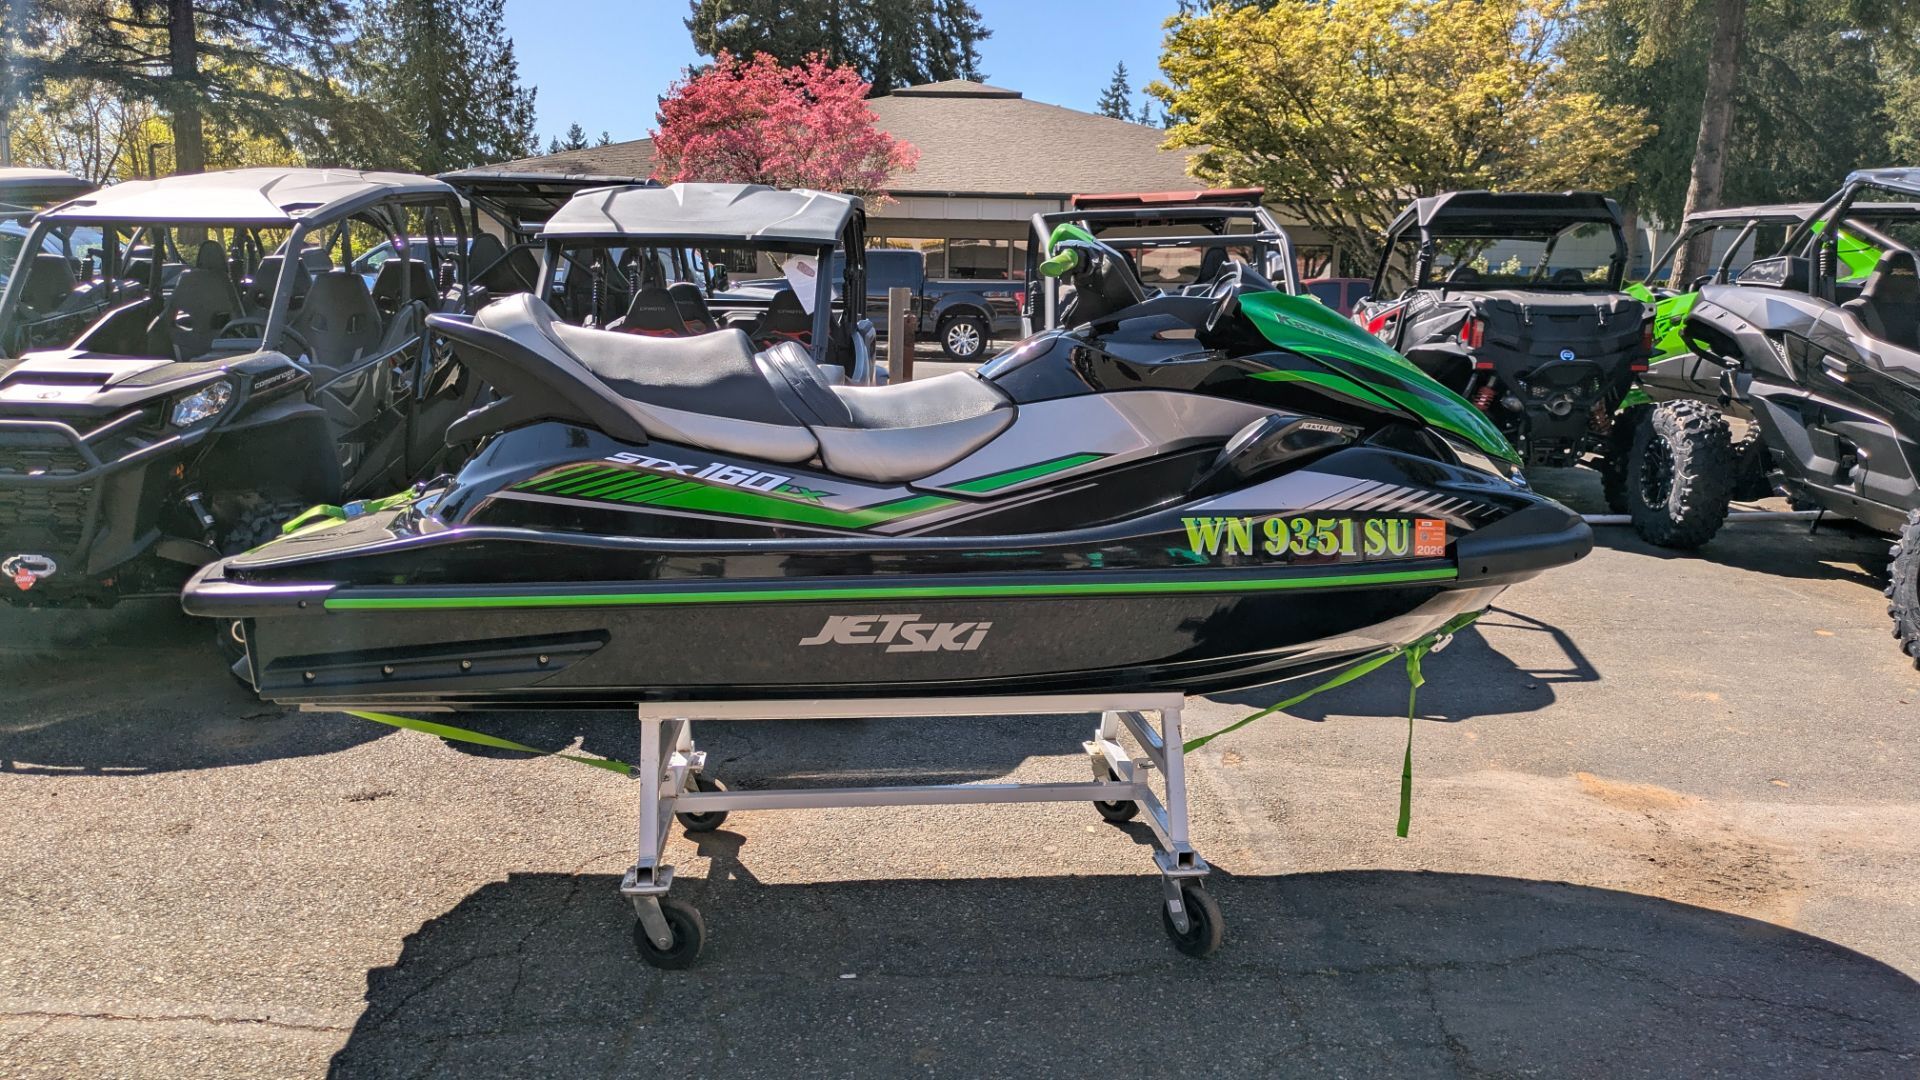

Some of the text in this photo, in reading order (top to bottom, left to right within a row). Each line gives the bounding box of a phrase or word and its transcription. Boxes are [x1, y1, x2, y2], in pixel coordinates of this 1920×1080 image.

[1299, 422, 1342, 433] JETSOUND
[604, 452, 698, 475] STX
[693, 462, 791, 492] 160
[1181, 517, 1410, 556] WN 9351 SU
[1416, 545, 1444, 555] 2026
